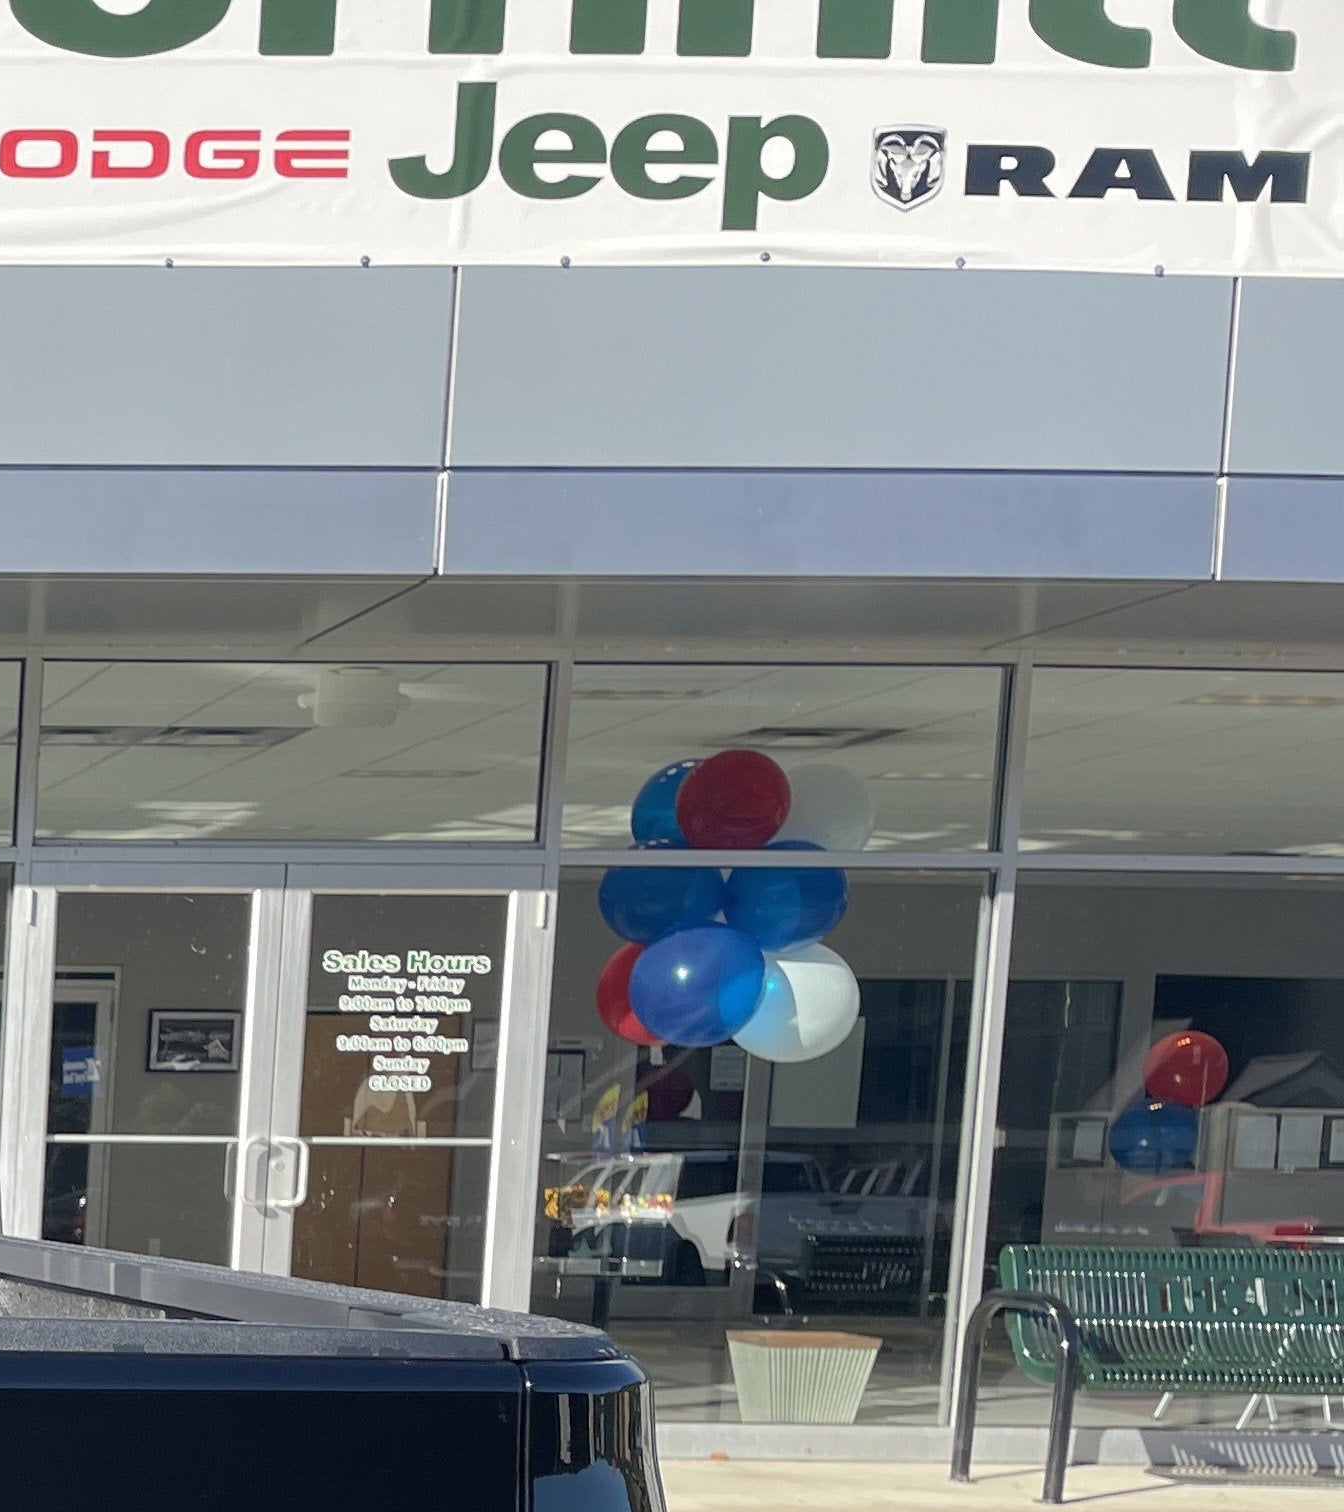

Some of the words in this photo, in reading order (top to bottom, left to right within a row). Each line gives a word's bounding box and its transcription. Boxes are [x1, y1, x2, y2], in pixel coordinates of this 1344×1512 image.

[388, 81, 830, 231] Jeep
[964, 143, 1313, 204] RAM
[323, 950, 401, 973] Sales
[407, 951, 491, 974] Hours
[348, 975, 407, 994] Monday
[416, 975, 465, 994] Friday
[396, 996, 414, 1012] to
[369, 1015, 438, 1034] Saturday
[393, 1036, 411, 1052] to
[373, 1055, 430, 1074] Sunday
[368, 1075, 431, 1092] CLOSED
